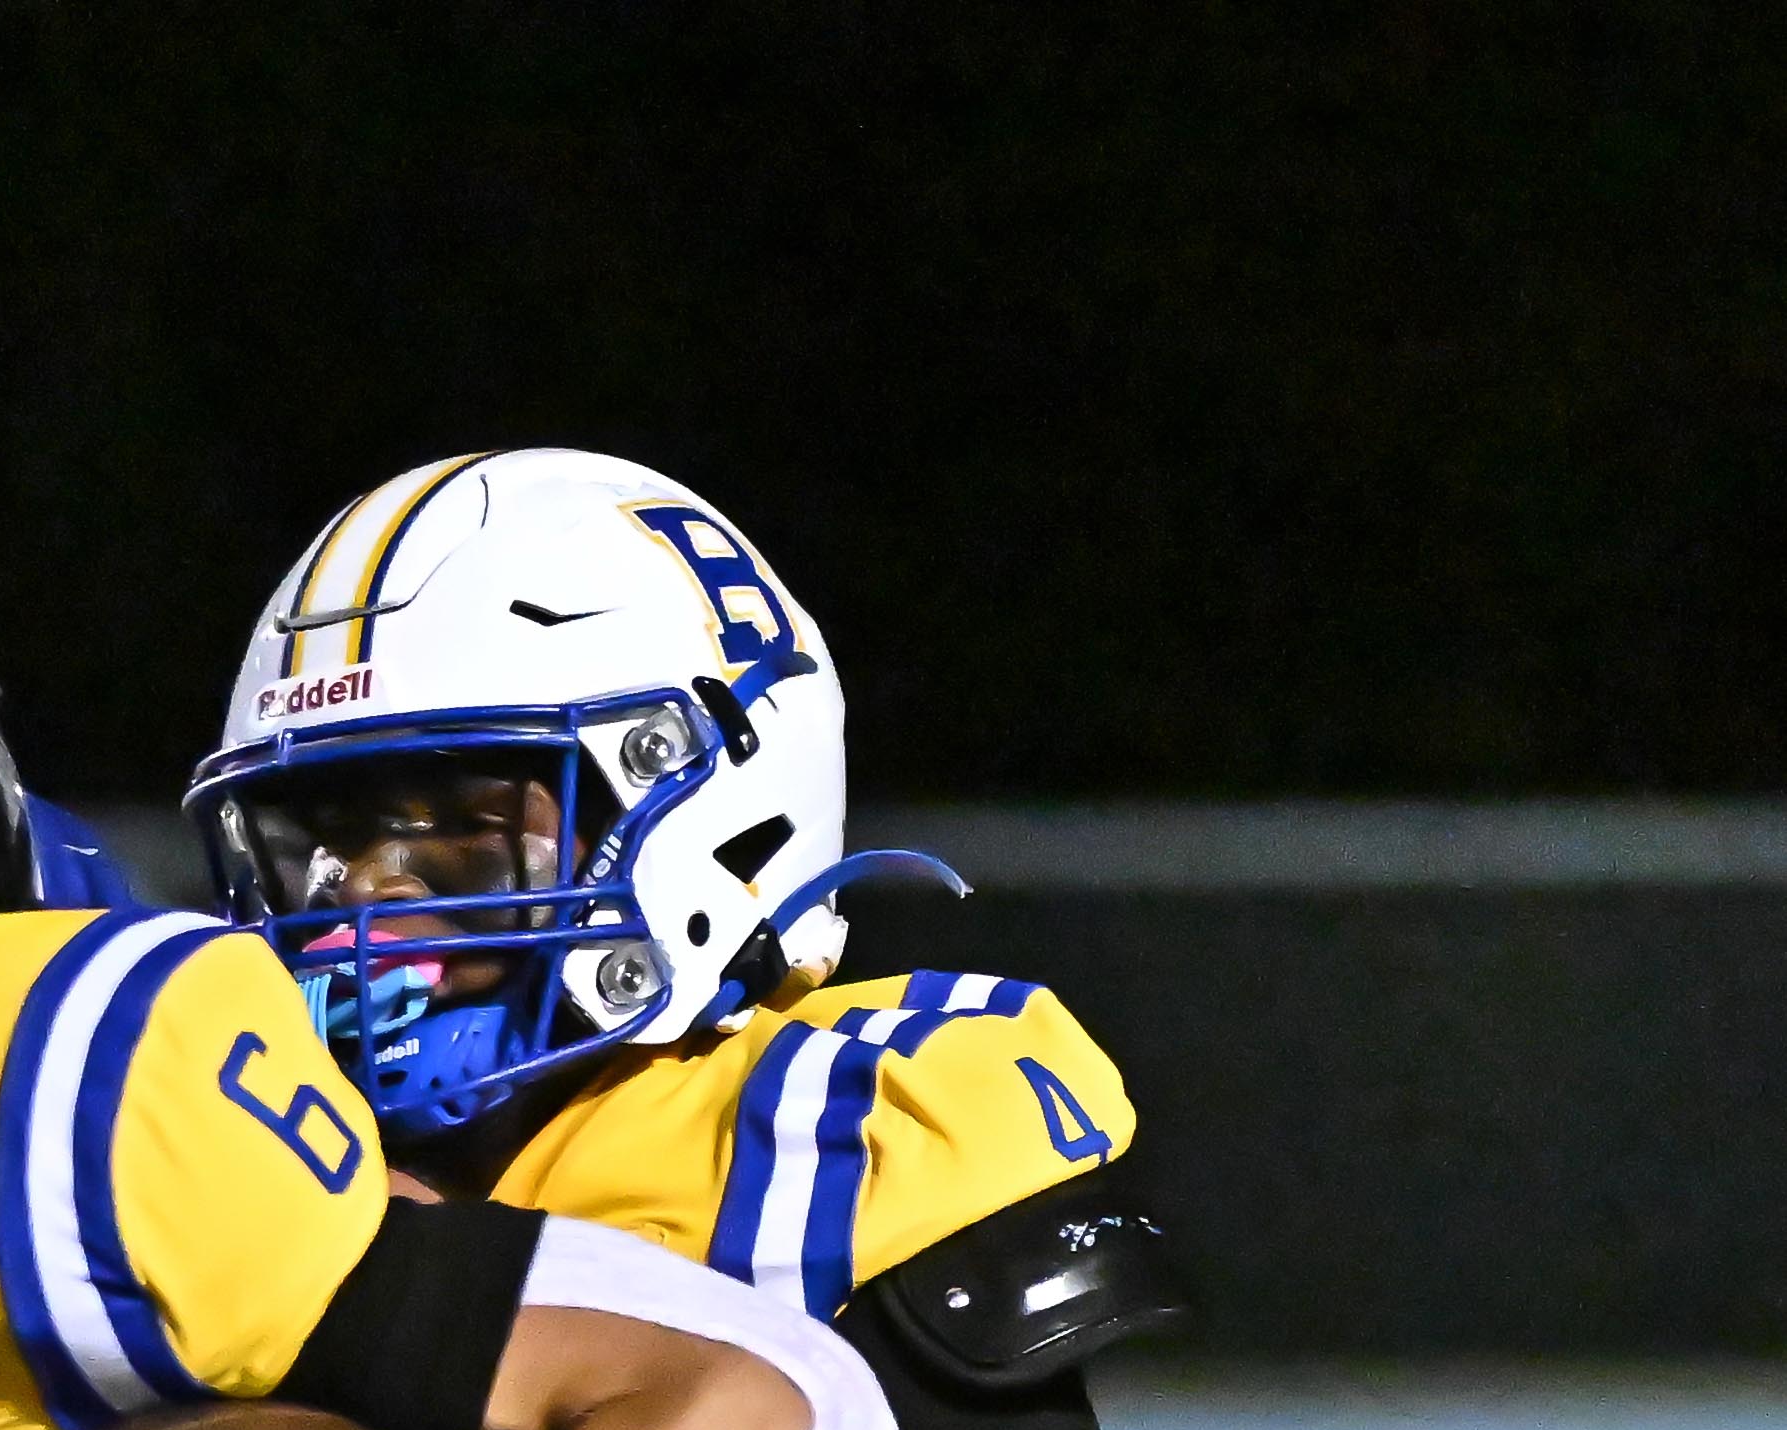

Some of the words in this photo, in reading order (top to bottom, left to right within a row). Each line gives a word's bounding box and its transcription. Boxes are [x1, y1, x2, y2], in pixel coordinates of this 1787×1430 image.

[618, 498, 806, 686] B
[218, 1030, 364, 1195] 6
[1014, 1056, 1113, 1166] 4
